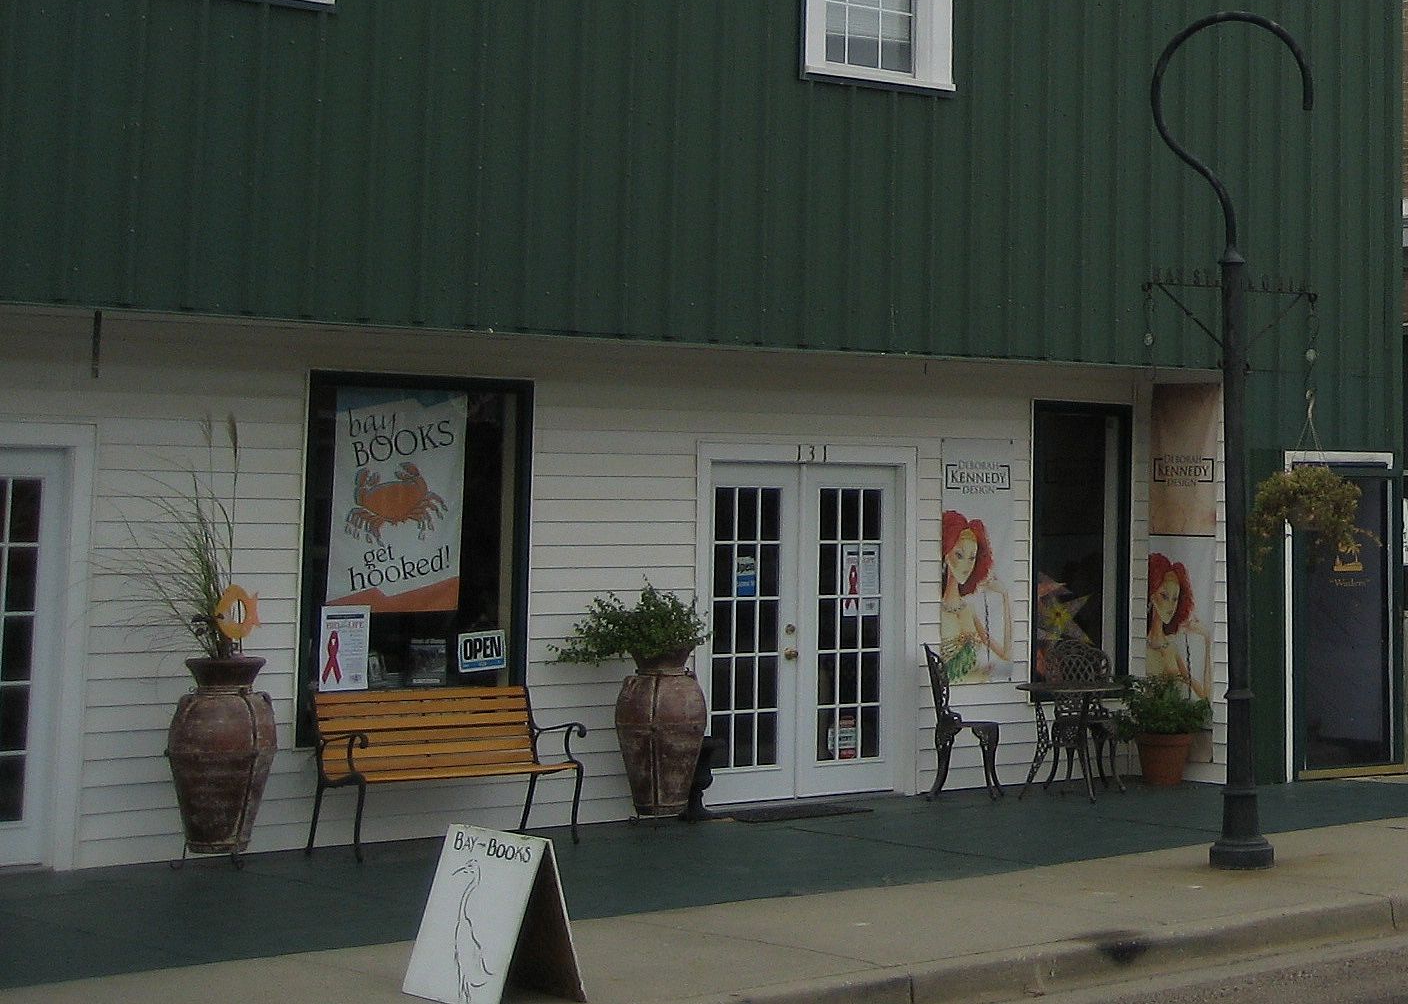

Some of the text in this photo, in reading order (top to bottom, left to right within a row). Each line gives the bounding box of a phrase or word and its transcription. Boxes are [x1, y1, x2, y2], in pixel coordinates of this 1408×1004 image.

[349, 409, 396, 445] bay
[352, 420, 455, 468] BOOKS
[797, 443, 827, 463] 131
[958, 460, 999, 470] DEBORAH
[1158, 464, 1209, 477] KENNEDY
[951, 469, 1006, 484] KENNEDY
[1166, 478, 1198, 488] DESIGN
[962, 485, 995, 495] DESIGN
[364, 545, 394, 571] get
[348, 545, 450, 592] hooked!
[463, 636, 502, 661] OPEN
